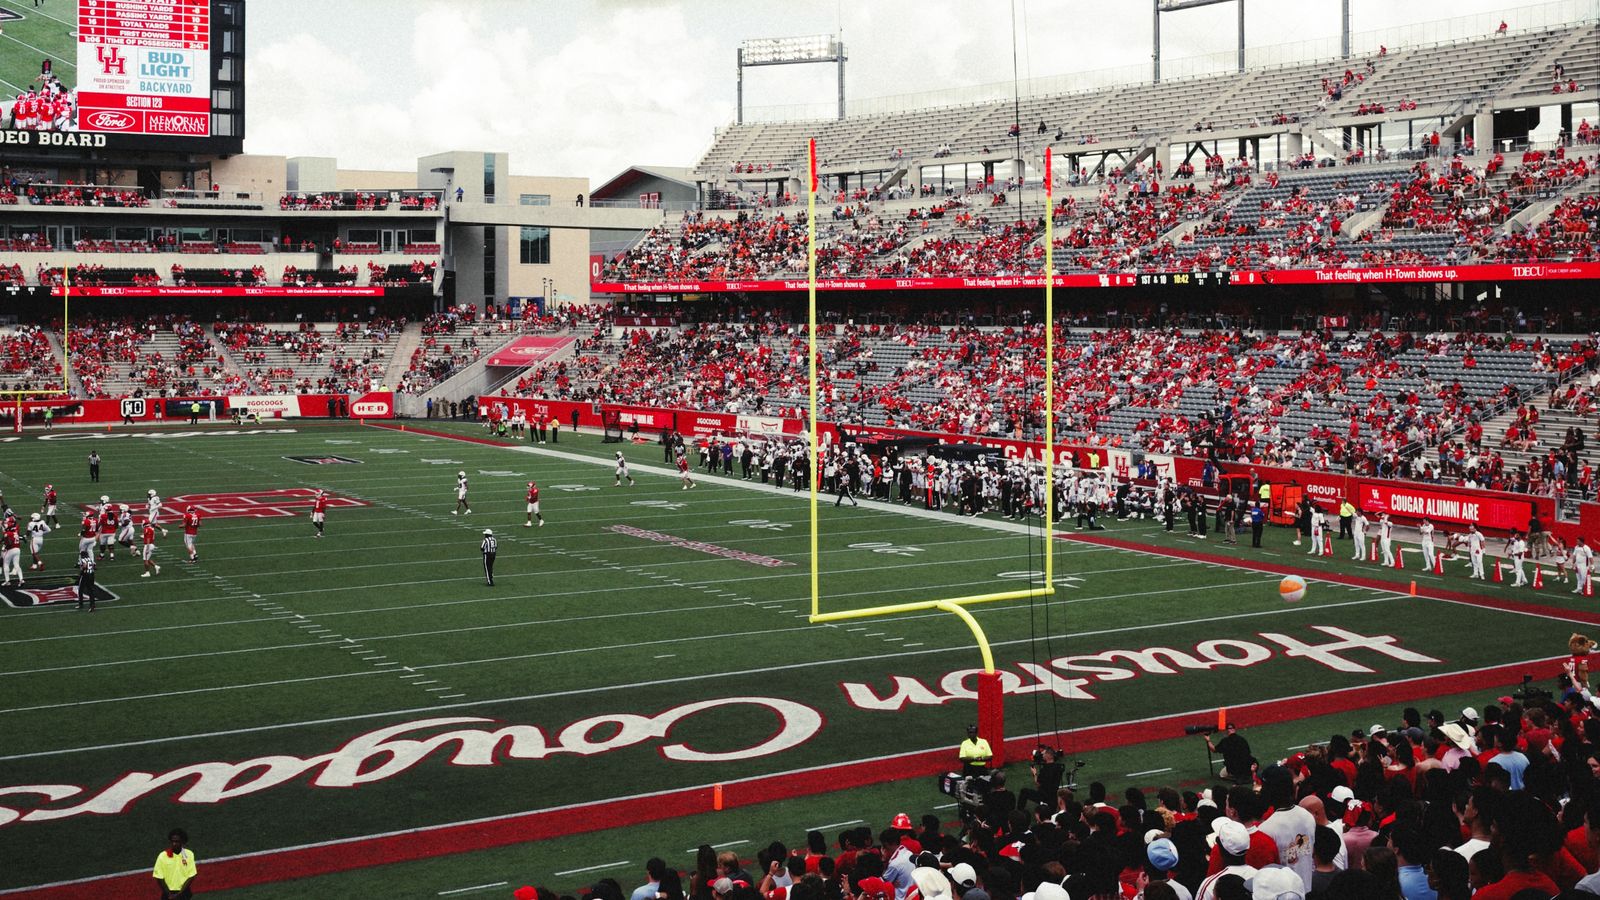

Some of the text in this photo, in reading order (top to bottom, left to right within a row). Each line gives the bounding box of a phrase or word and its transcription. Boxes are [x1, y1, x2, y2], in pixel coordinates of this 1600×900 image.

[116, 3, 148, 11] RUSHING
[116, 11, 148, 19] PASSING
[120, 20, 143, 28] TOTAL
[145, 22, 169, 30] YARDS
[107, 37, 125, 45] TIME
[137, 40, 182, 48] POSSESSION
[96, 46, 126, 75] UH
[148, 51, 184, 64] BUD
[141, 64, 191, 78] LIGHT
[140, 81, 193, 94] BACKYARD
[126, 96, 151, 108] SECTION
[95, 113, 126, 128] Ford
[149, 115, 205, 127] MEMORIAL
[149, 122, 205, 133] HERMANN
[38, 131, 107, 147] BOARD
[1315, 269, 1458, 282] That feeling when H-Town shows up.
[1512, 266, 1545, 277] TDECU
[977, 278, 995, 287] feeling
[996, 278, 1012, 286] when
[1037, 278, 1054, 286] shos
[1056, 278, 1064, 286] up.
[1141, 275, 1151, 285] 1ST
[1160, 275, 1167, 284] 10
[1173, 274, 1189, 284] 10:42
[1249, 273, 1254, 283] 0
[624, 283, 637, 291] That
[785, 281, 796, 289] That
[796, 281, 810, 289] feelin
[825, 281, 843, 289] H-Town
[843, 281, 858, 289] shows
[859, 281, 867, 289] up.
[1114, 456, 1130, 478] UH
[1306, 484, 1336, 496] GROUP
[1391, 494, 1480, 521] COUGAR ALUMNI ARE
[32, 524, 45, 533] 44
[838, 624, 1445, 712] Houston
[0, 696, 823, 827] Cougars
